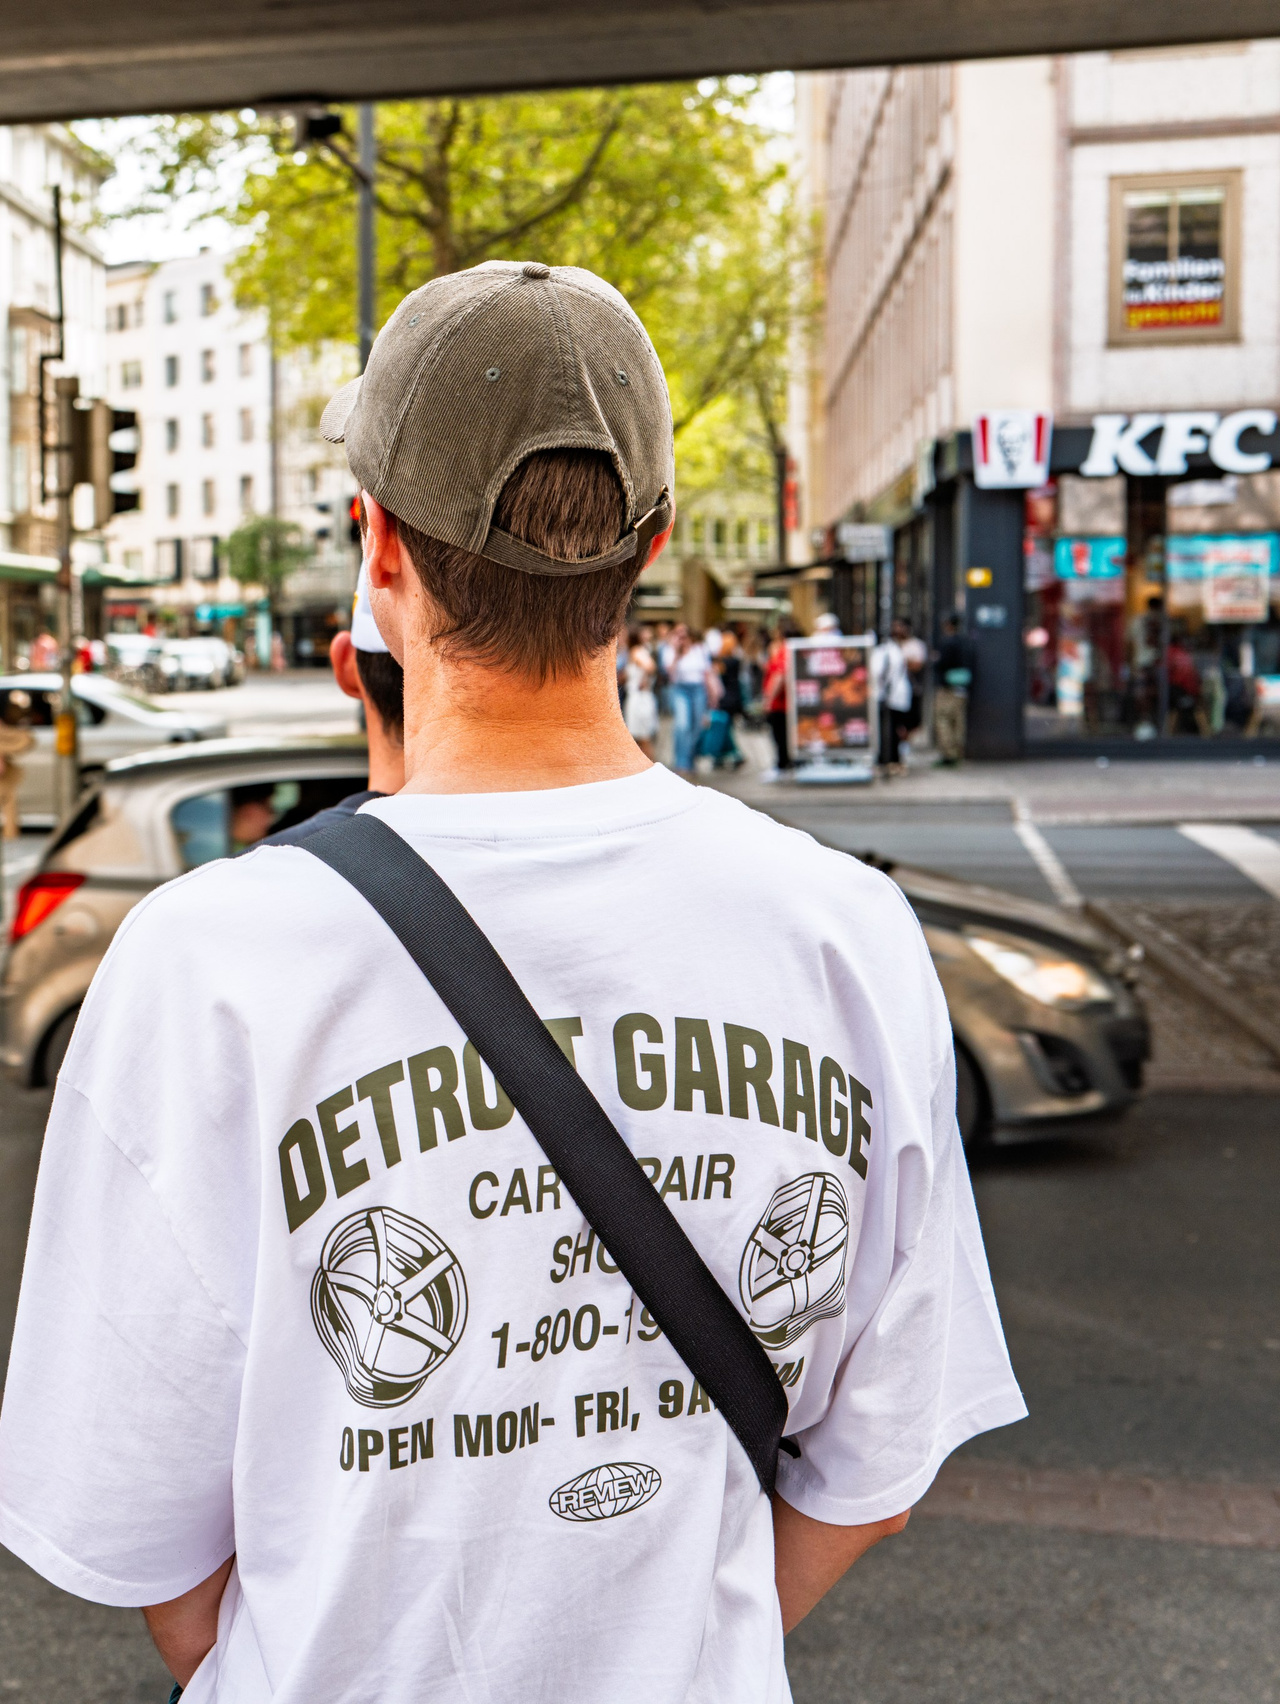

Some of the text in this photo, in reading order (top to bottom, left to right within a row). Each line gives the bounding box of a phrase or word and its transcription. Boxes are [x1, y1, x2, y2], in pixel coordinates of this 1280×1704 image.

[1080, 409, 1277, 477] KFC
[278, 1012, 873, 1234] DETRO GARAGE
[469, 1153, 736, 1219] CAR PAIR
[550, 1229, 621, 1283] SHO
[339, 1417, 434, 1472] OPEN
[453, 1401, 555, 1458] MON-
[574, 1386, 640, 1438] FRI,
[558, 1470, 654, 1514] REVIEW
